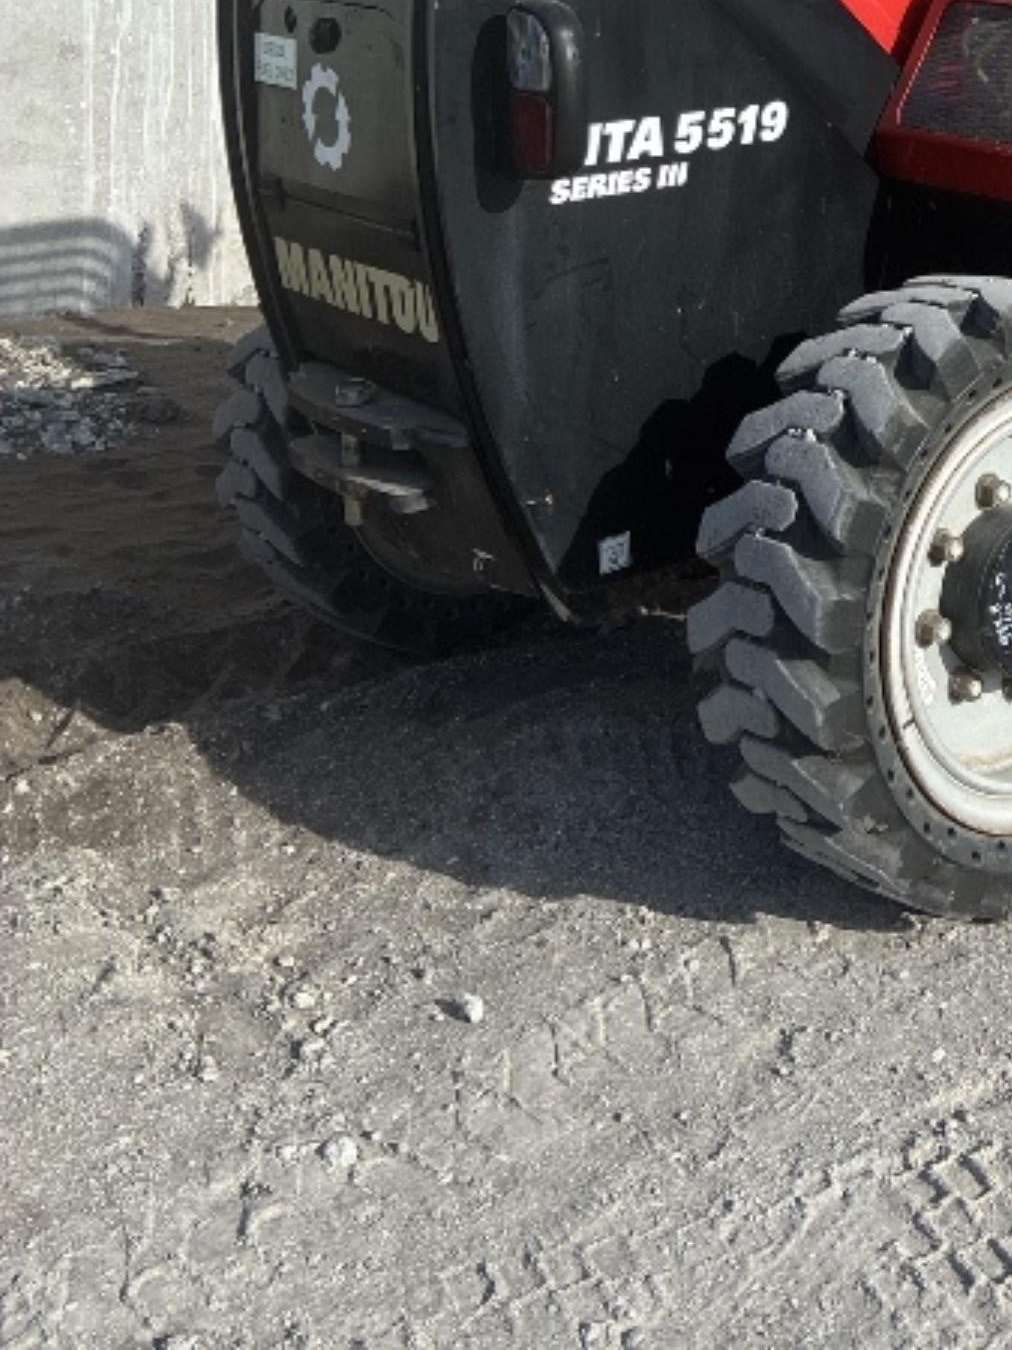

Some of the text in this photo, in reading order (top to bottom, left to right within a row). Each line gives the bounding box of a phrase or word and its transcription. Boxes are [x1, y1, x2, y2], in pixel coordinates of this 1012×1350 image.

[584, 100, 789, 167] ITA 5519
[549, 161, 690, 206] SERIES III
[274, 236, 440, 344] MANITOU
